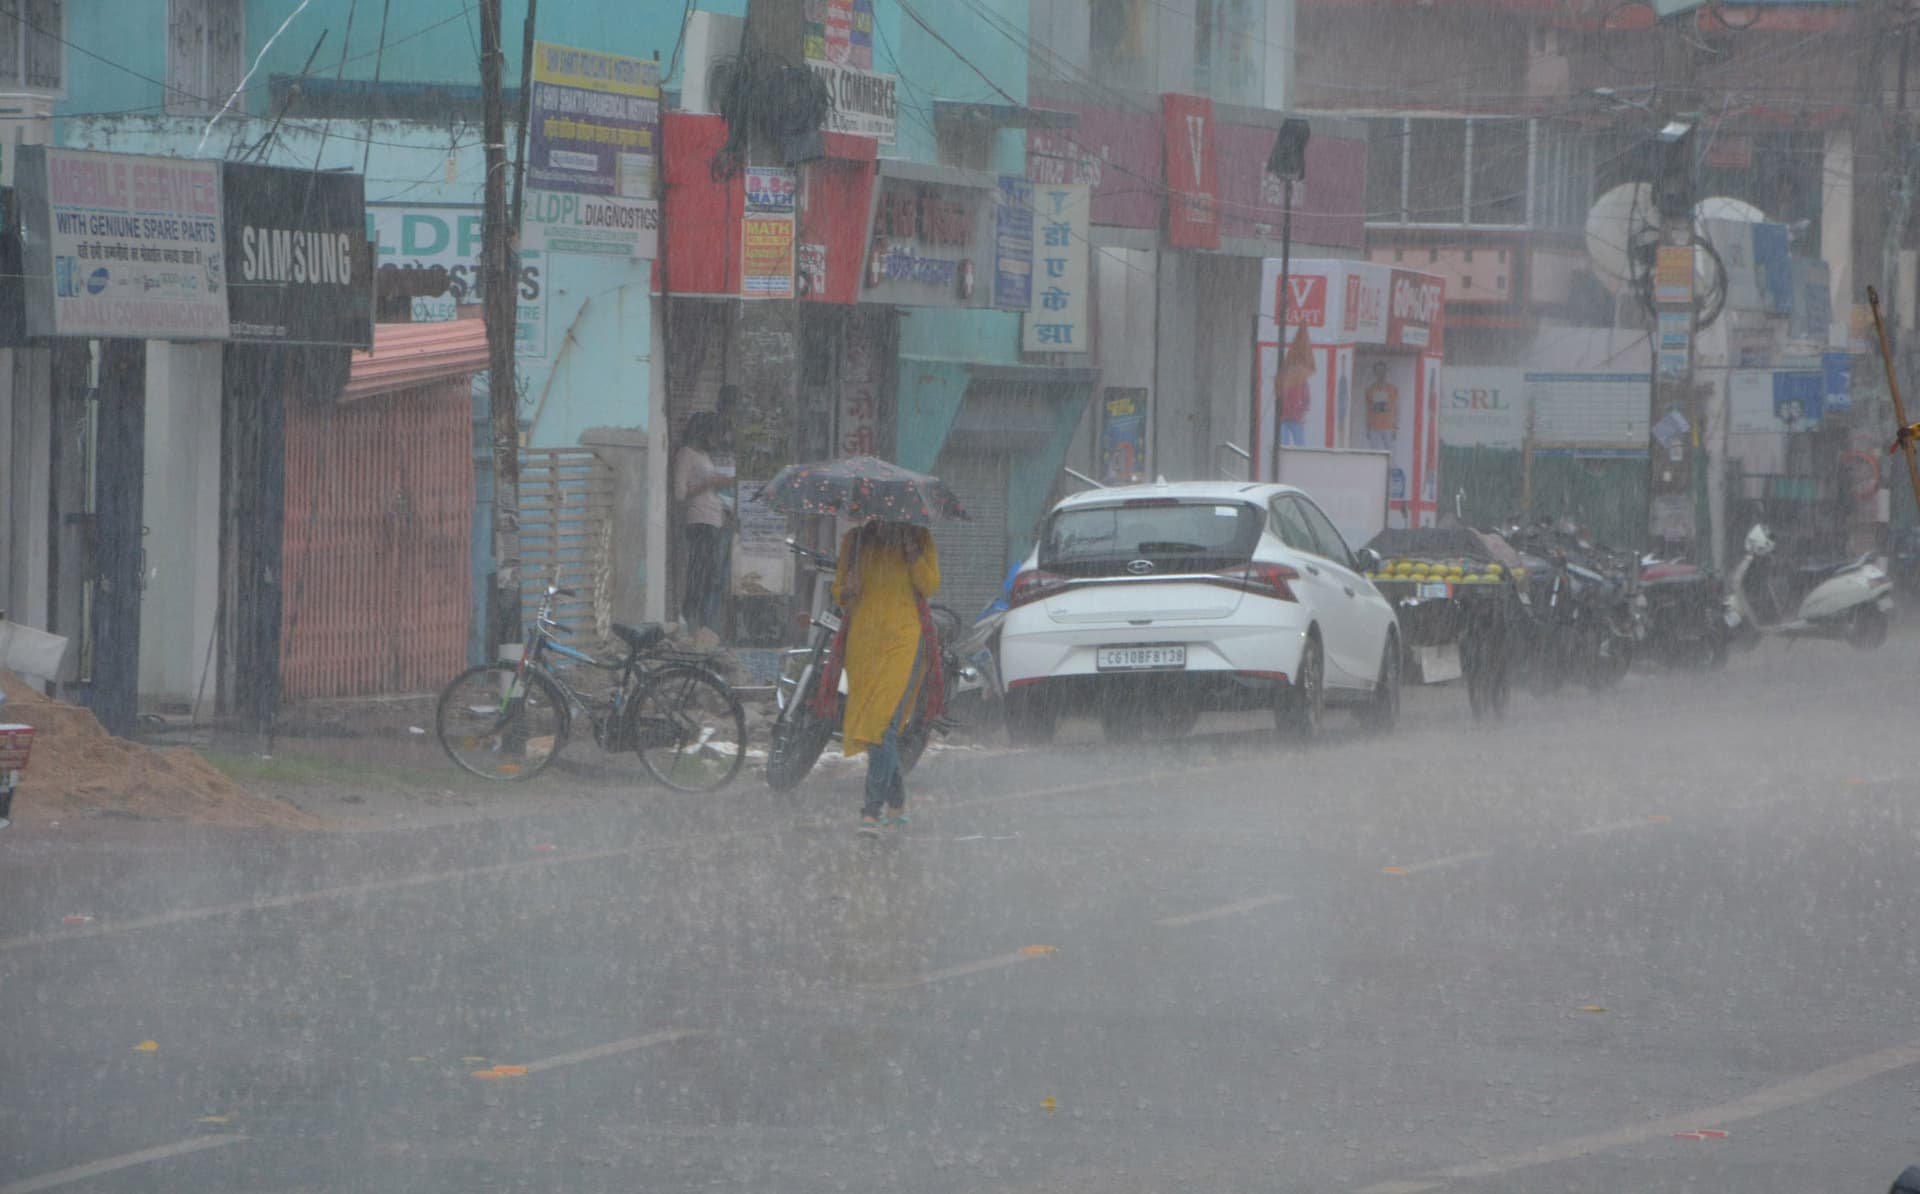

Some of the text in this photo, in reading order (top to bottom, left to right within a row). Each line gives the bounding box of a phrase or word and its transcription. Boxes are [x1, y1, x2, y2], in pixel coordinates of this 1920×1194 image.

[1186, 115, 1205, 185] V
[51, 158, 217, 214] MOBILE SERVICE
[747, 192, 793, 206] MATH
[535, 192, 658, 230] LDPL DIAGNOSTICS
[56, 213, 216, 243] WITH GENIUNE SPARE PARTS
[746, 222, 790, 235] MATH
[243, 225, 351, 285] SAMSUNG
[1288, 279, 1317, 308] V
[1452, 389, 1510, 409] SRL
